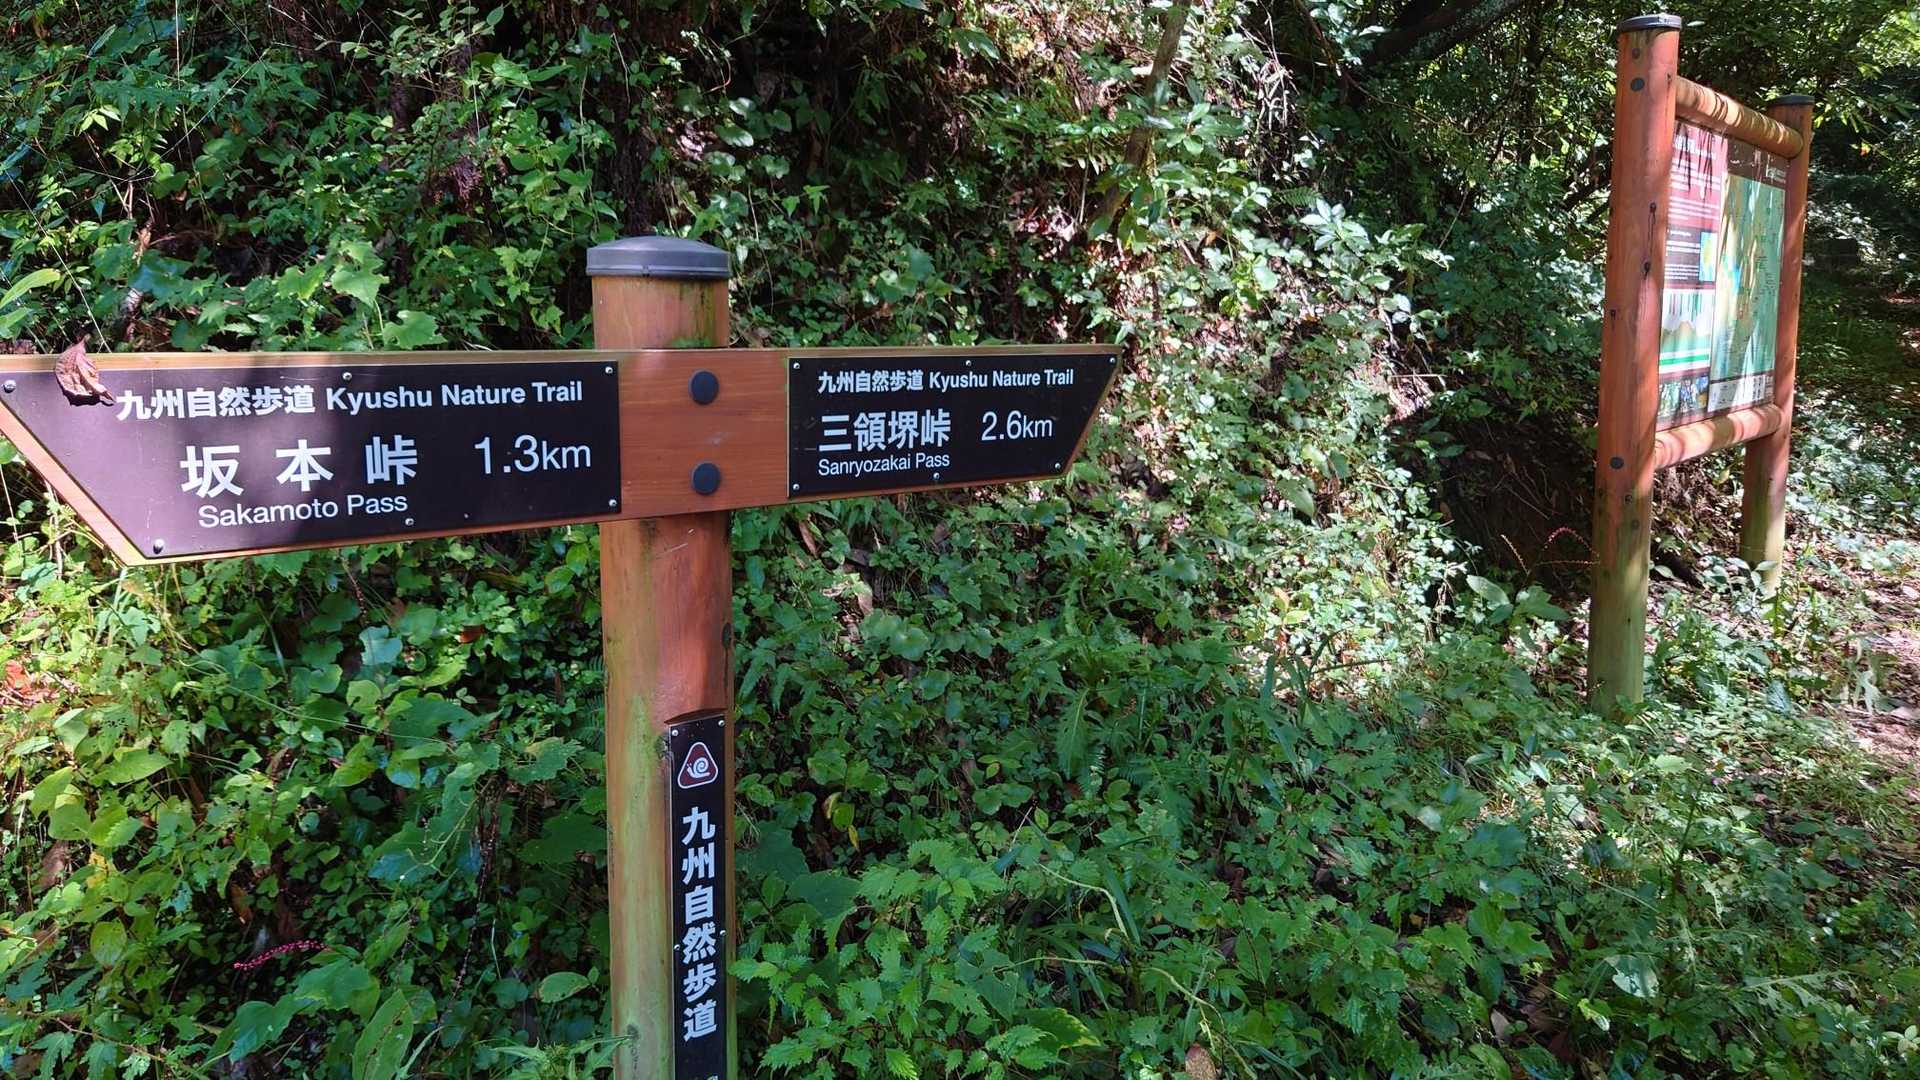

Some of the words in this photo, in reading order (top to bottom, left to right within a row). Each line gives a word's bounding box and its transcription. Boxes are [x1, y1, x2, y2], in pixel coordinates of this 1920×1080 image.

[818, 371, 924, 393] 九州自然歩道
[929, 372, 988, 392] Kyushu
[992, 371, 1041, 387] Nature
[1044, 368, 1074, 385] Trail
[116, 385, 315, 421] 九州自然歩道
[326, 386, 432, 413] Kyushu
[441, 382, 526, 405] Nature
[531, 381, 583, 402] Trail
[819, 408, 951, 452] 三領堺峠
[980, 410, 1053, 441] 2.6km
[180, 435, 418, 498] 坂本峠
[474, 434, 591, 474] 1.3km
[818, 453, 911, 477] Sanryozakai
[915, 452, 951, 468] Pass
[198, 499, 339, 528] Sakamoto
[347, 495, 408, 514] Pass
[681, 806, 718, 1041] 九州自然歩道
